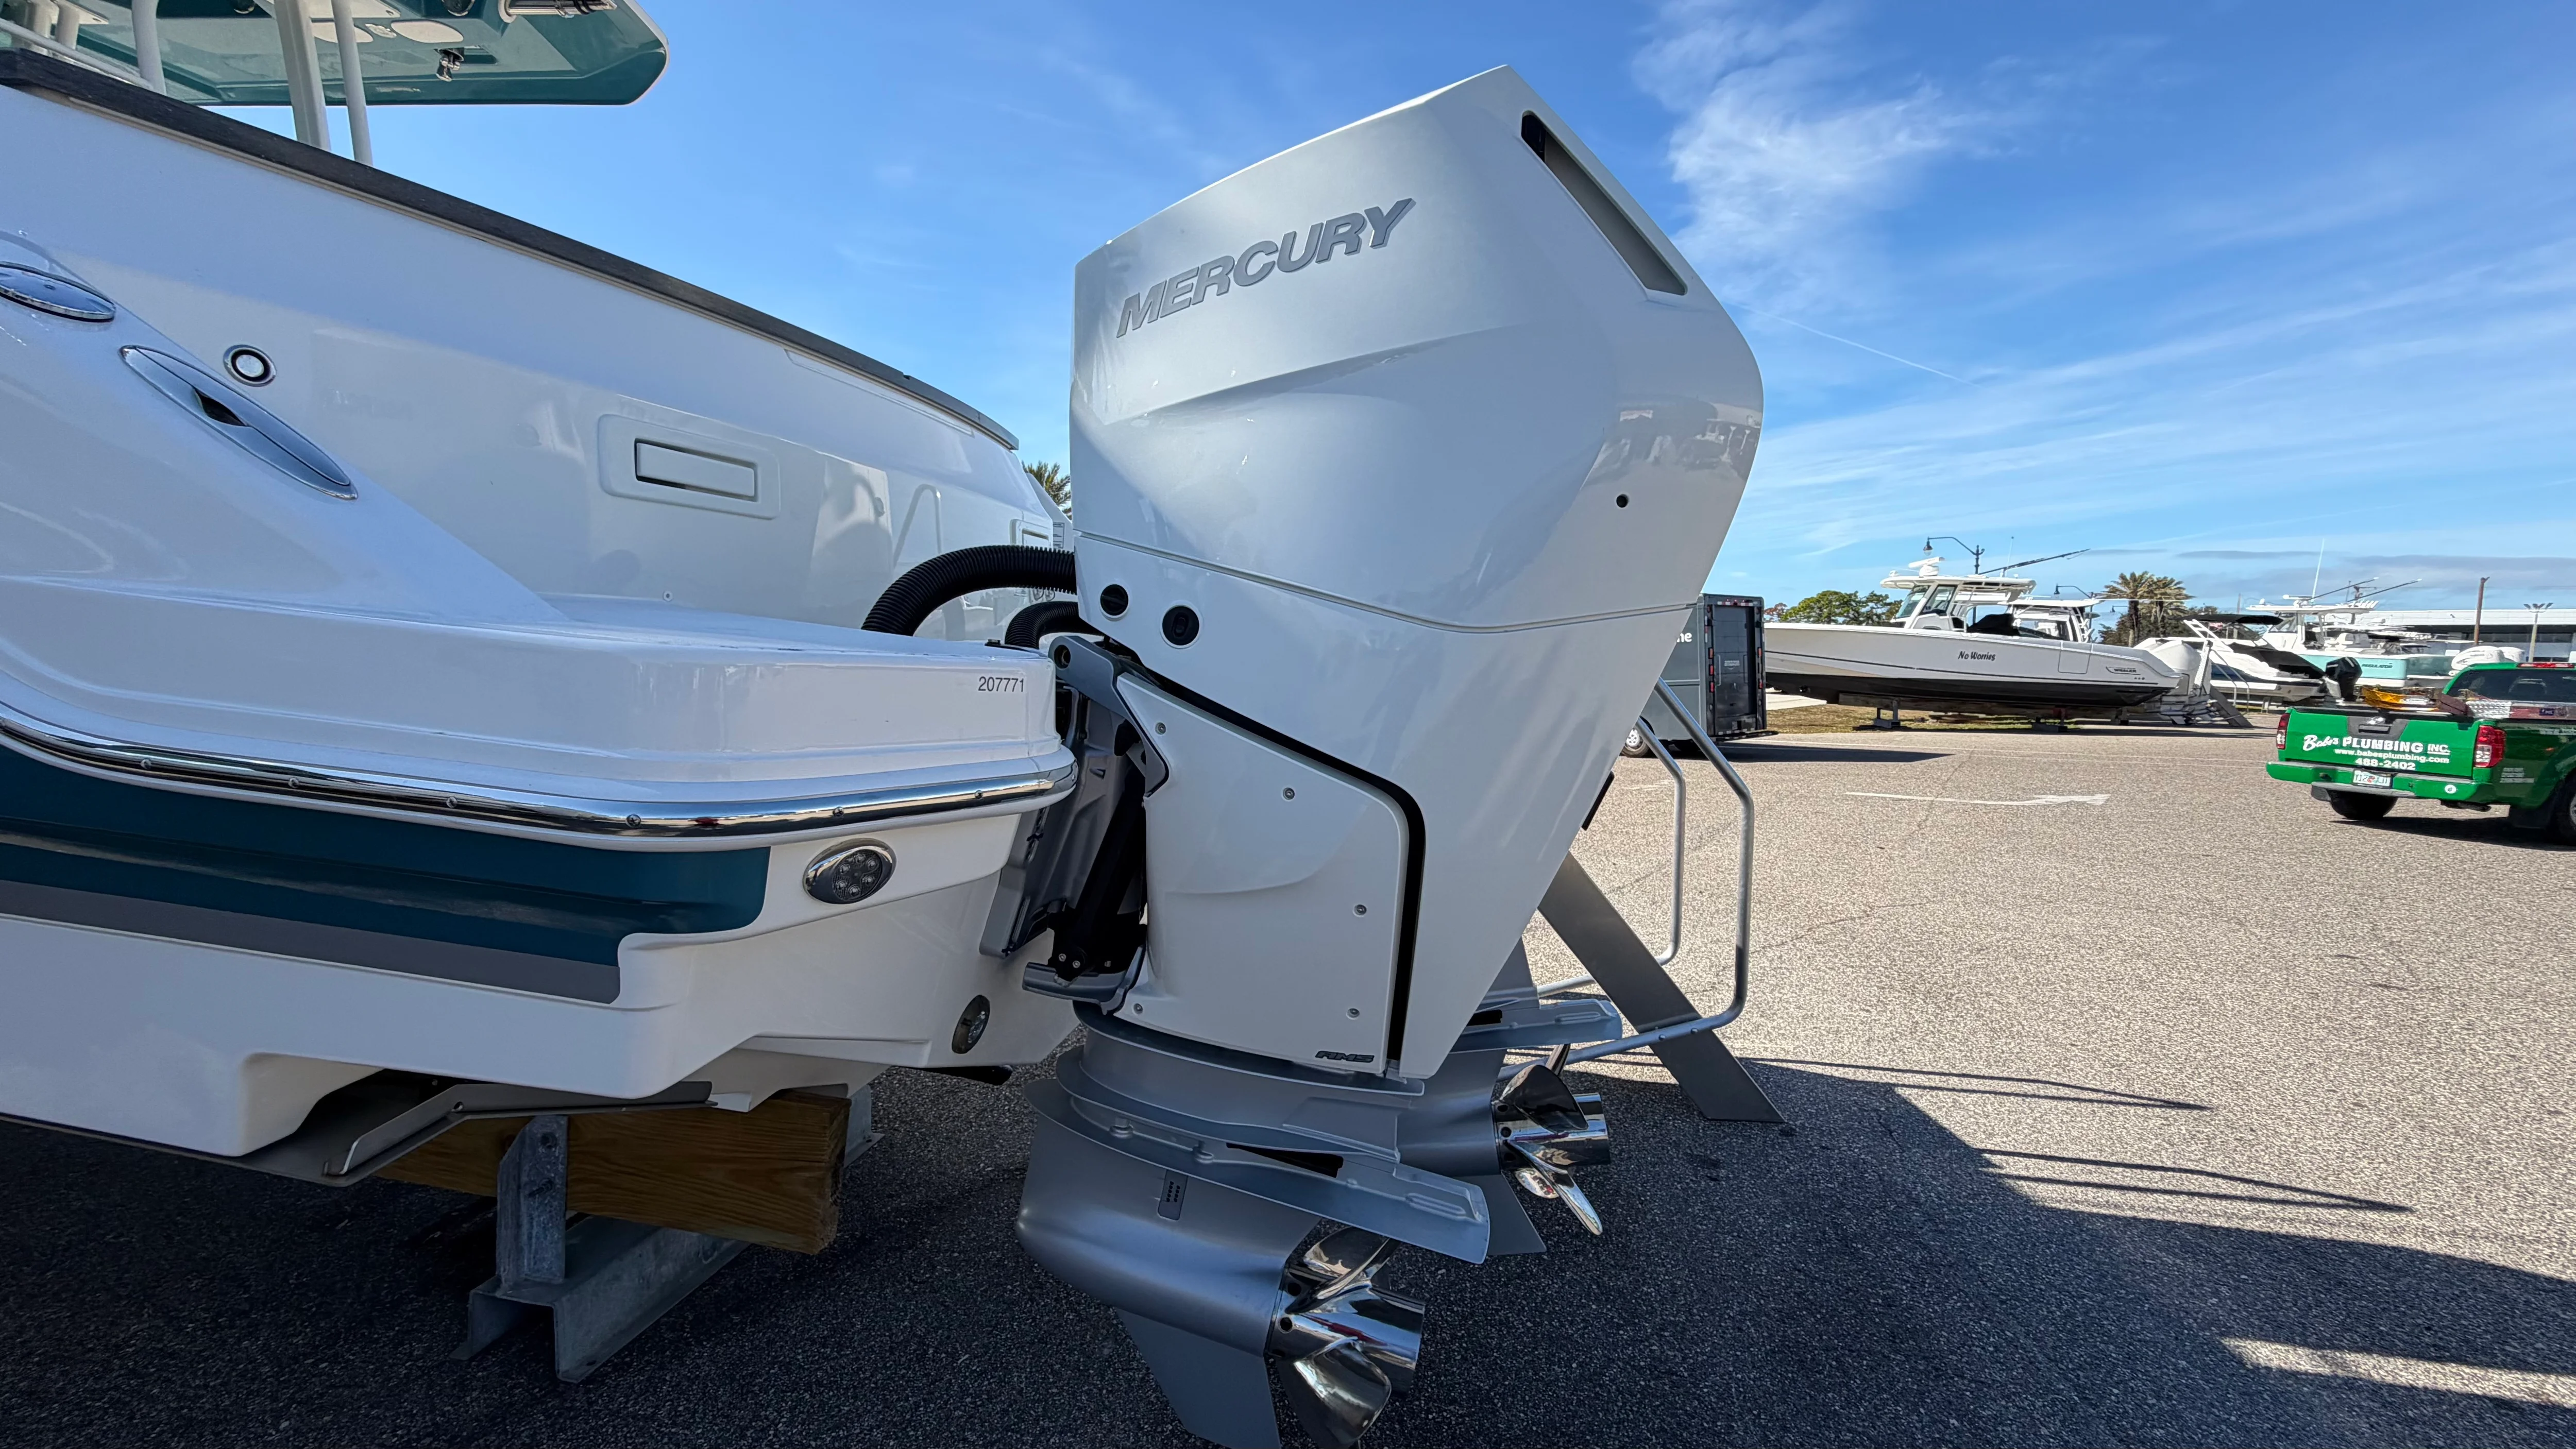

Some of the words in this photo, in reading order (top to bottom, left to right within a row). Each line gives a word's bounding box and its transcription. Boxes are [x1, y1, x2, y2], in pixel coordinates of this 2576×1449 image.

[1116, 198, 1416, 338] MERCURY
[1958, 651, 1969, 659] No
[1971, 651, 1996, 661] Worries
[978, 676, 1024, 692] 207771
[2343, 736, 2424, 753] PLUMBING
[2427, 743, 2451, 753] INC.
[2334, 748, 2450, 763] www.babesplumbing.com
[2355, 758, 2416, 770] 488-2402
[1315, 1050, 1375, 1063] AMS
